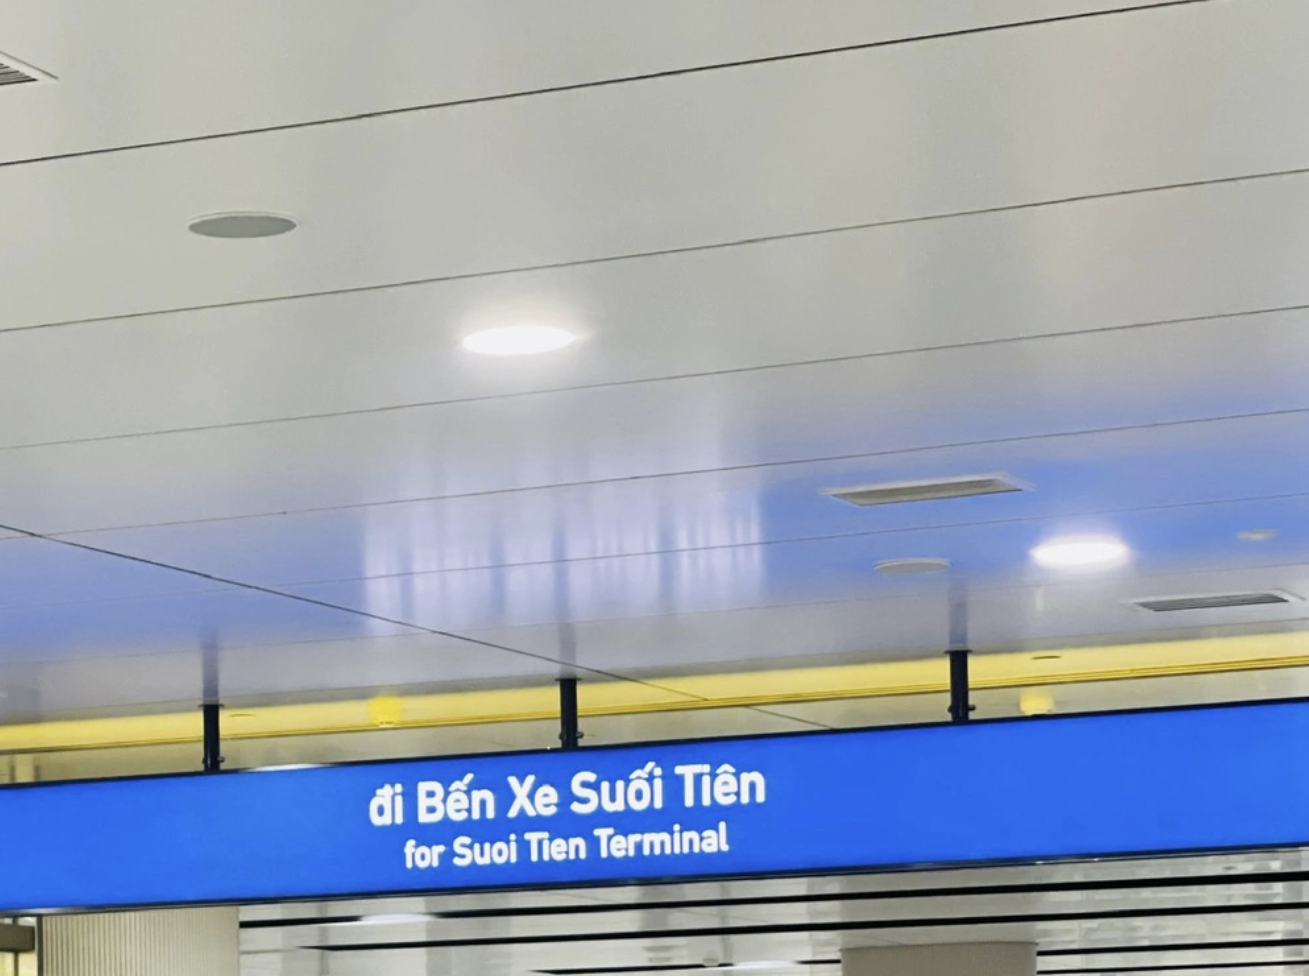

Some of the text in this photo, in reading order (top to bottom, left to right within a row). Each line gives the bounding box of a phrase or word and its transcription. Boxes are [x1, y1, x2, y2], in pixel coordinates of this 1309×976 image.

[369, 761, 766, 826] đi Bến Xe Suối Tiên
[403, 821, 730, 869] for Suoi Tien Terminal
